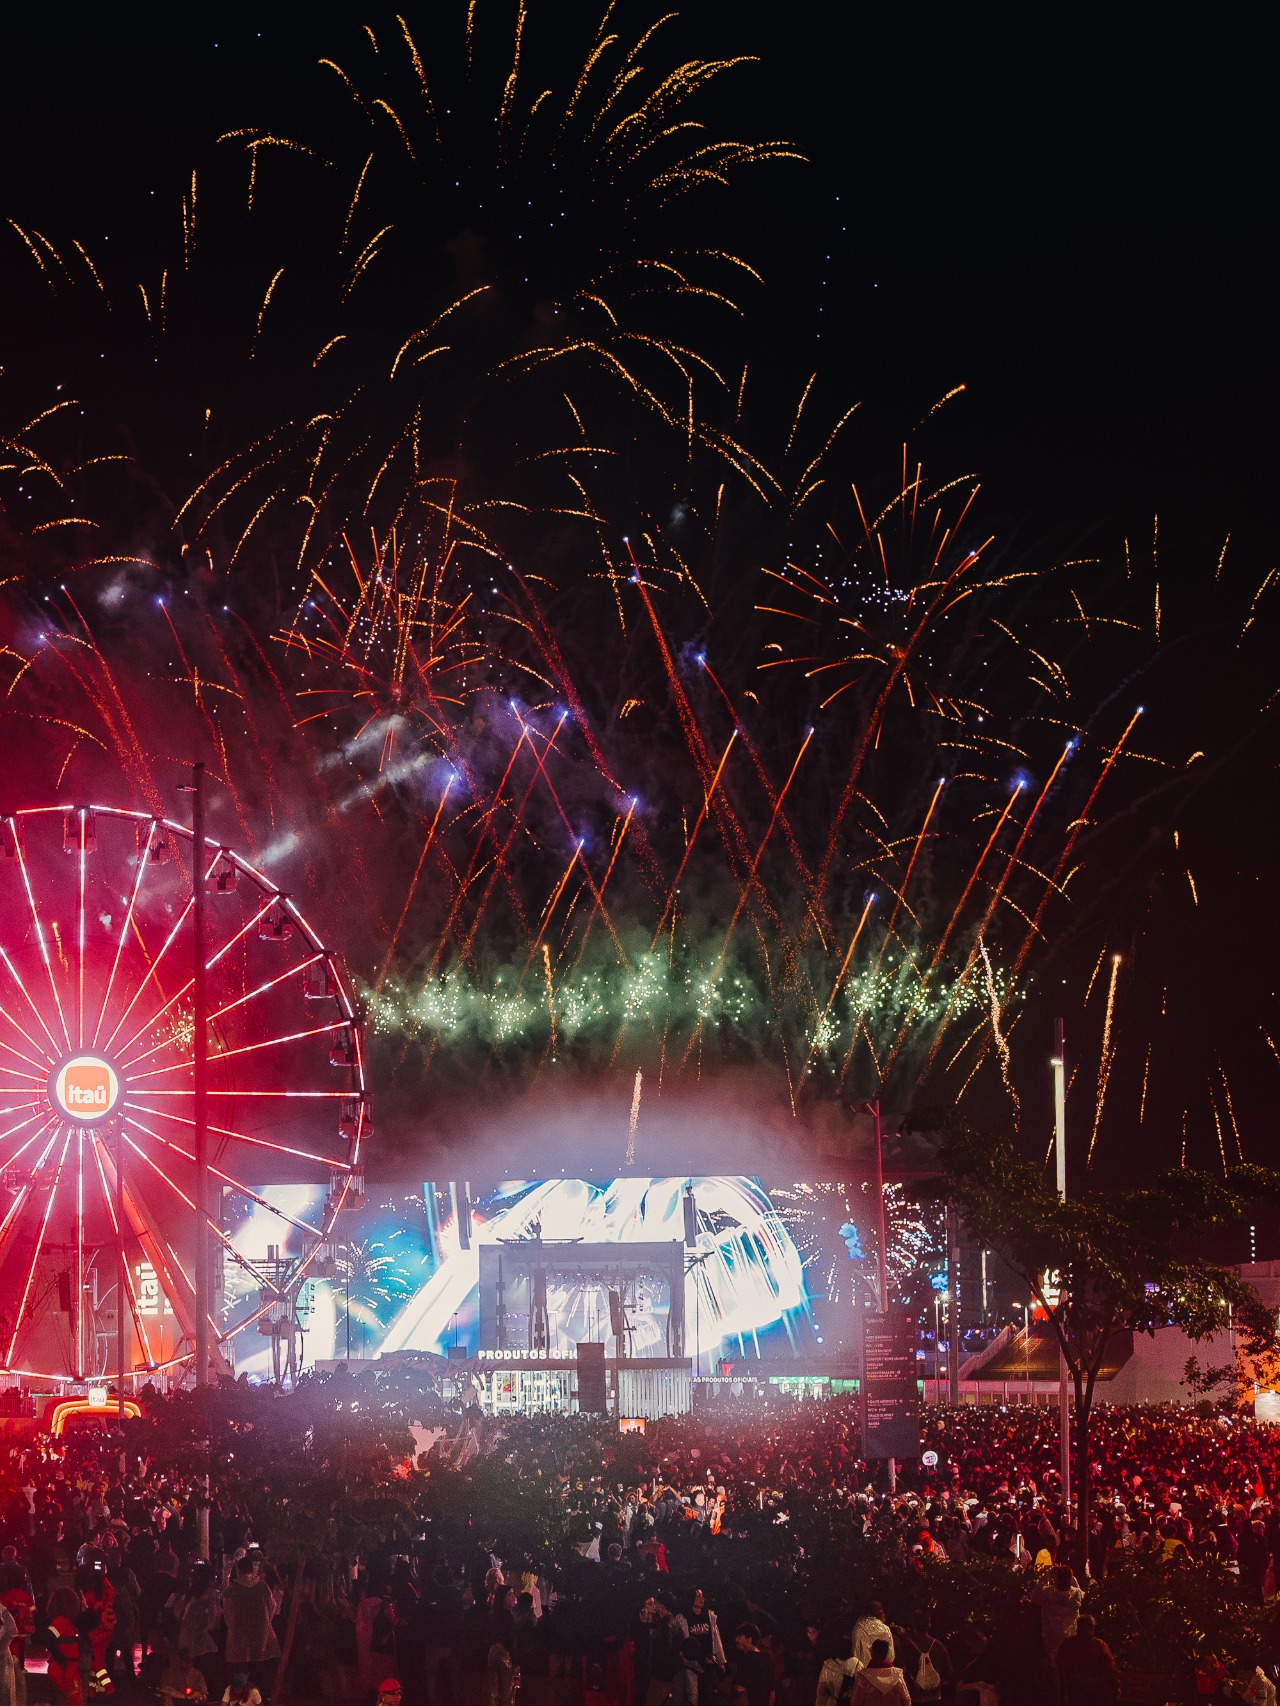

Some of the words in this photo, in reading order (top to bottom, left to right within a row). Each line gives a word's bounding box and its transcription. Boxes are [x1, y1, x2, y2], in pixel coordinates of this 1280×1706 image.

[68, 1085, 107, 1104] itaú
[135, 1262, 158, 1315] itaú
[478, 1350, 547, 1360] PRODUTOS
